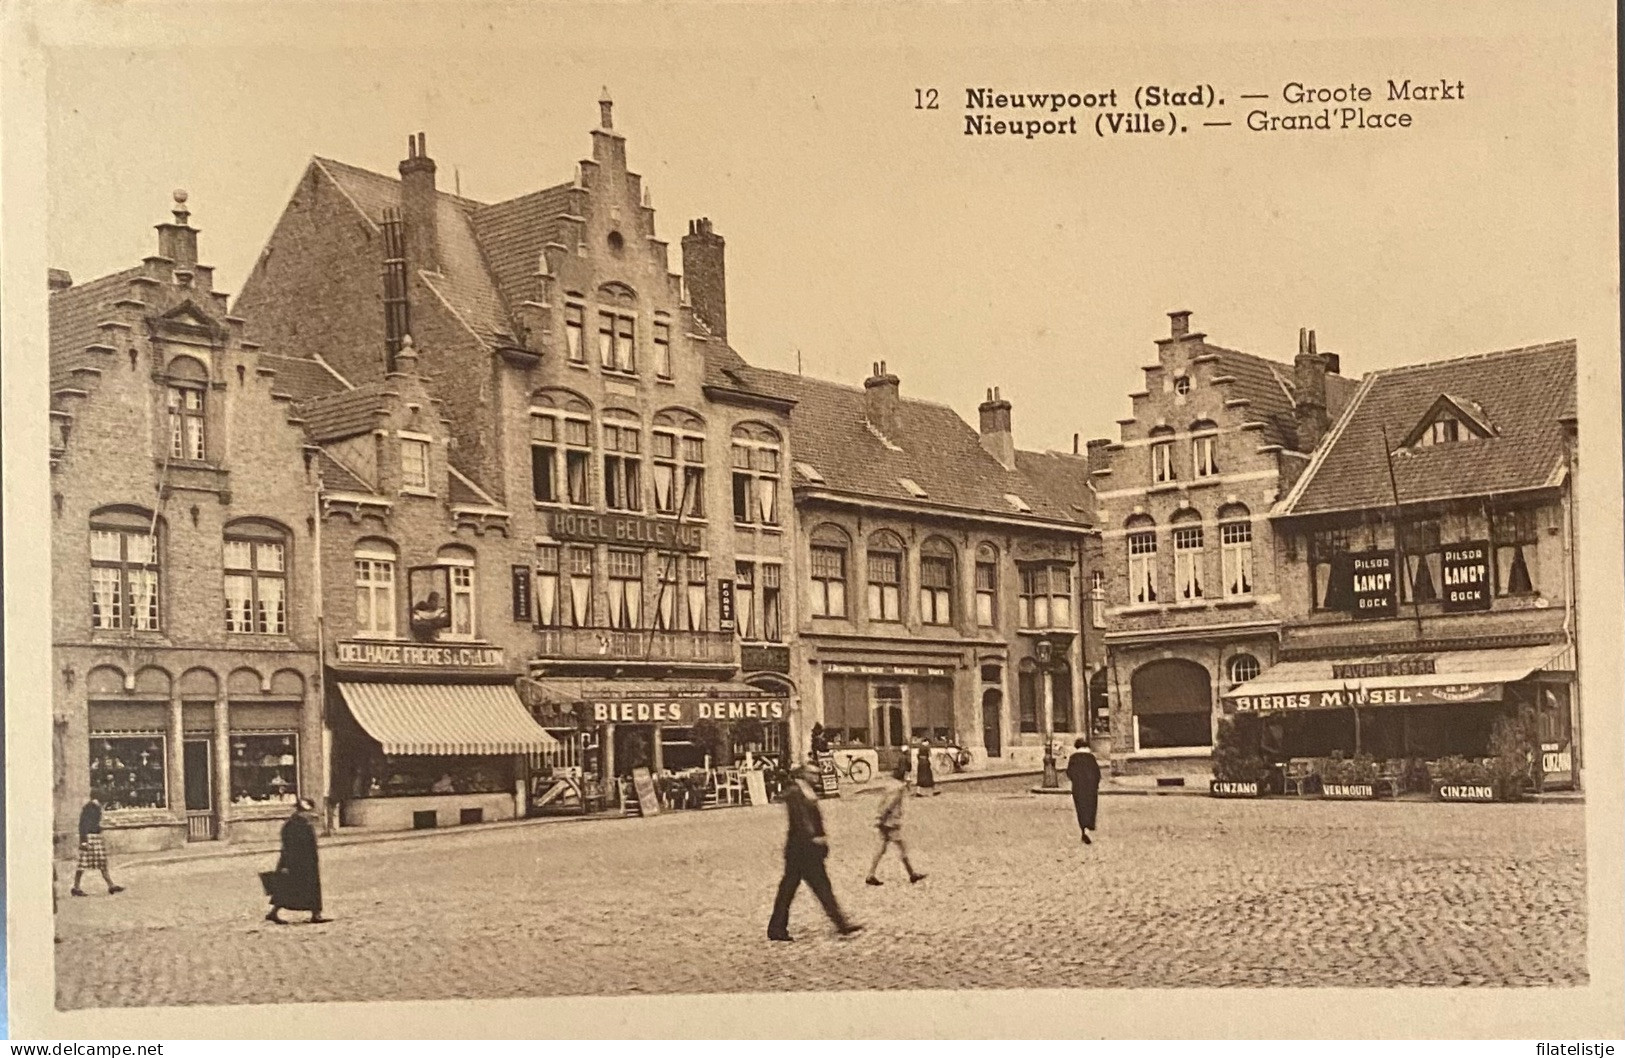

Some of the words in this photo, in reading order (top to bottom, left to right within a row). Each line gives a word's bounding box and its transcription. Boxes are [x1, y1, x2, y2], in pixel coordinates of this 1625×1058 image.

[554, 513, 609, 538] HOTEL
[616, 520, 665, 544] BELLE
[1450, 590, 1481, 602] BOCK
[1359, 598, 1388, 608] BOCK
[699, 701, 783, 719] DEMETS
[1542, 752, 1572, 772] CINZ
[1213, 782, 1258, 794] CINZANO
[1323, 784, 1373, 796] VERMOUTH
[1440, 785, 1493, 798] CINZANO
